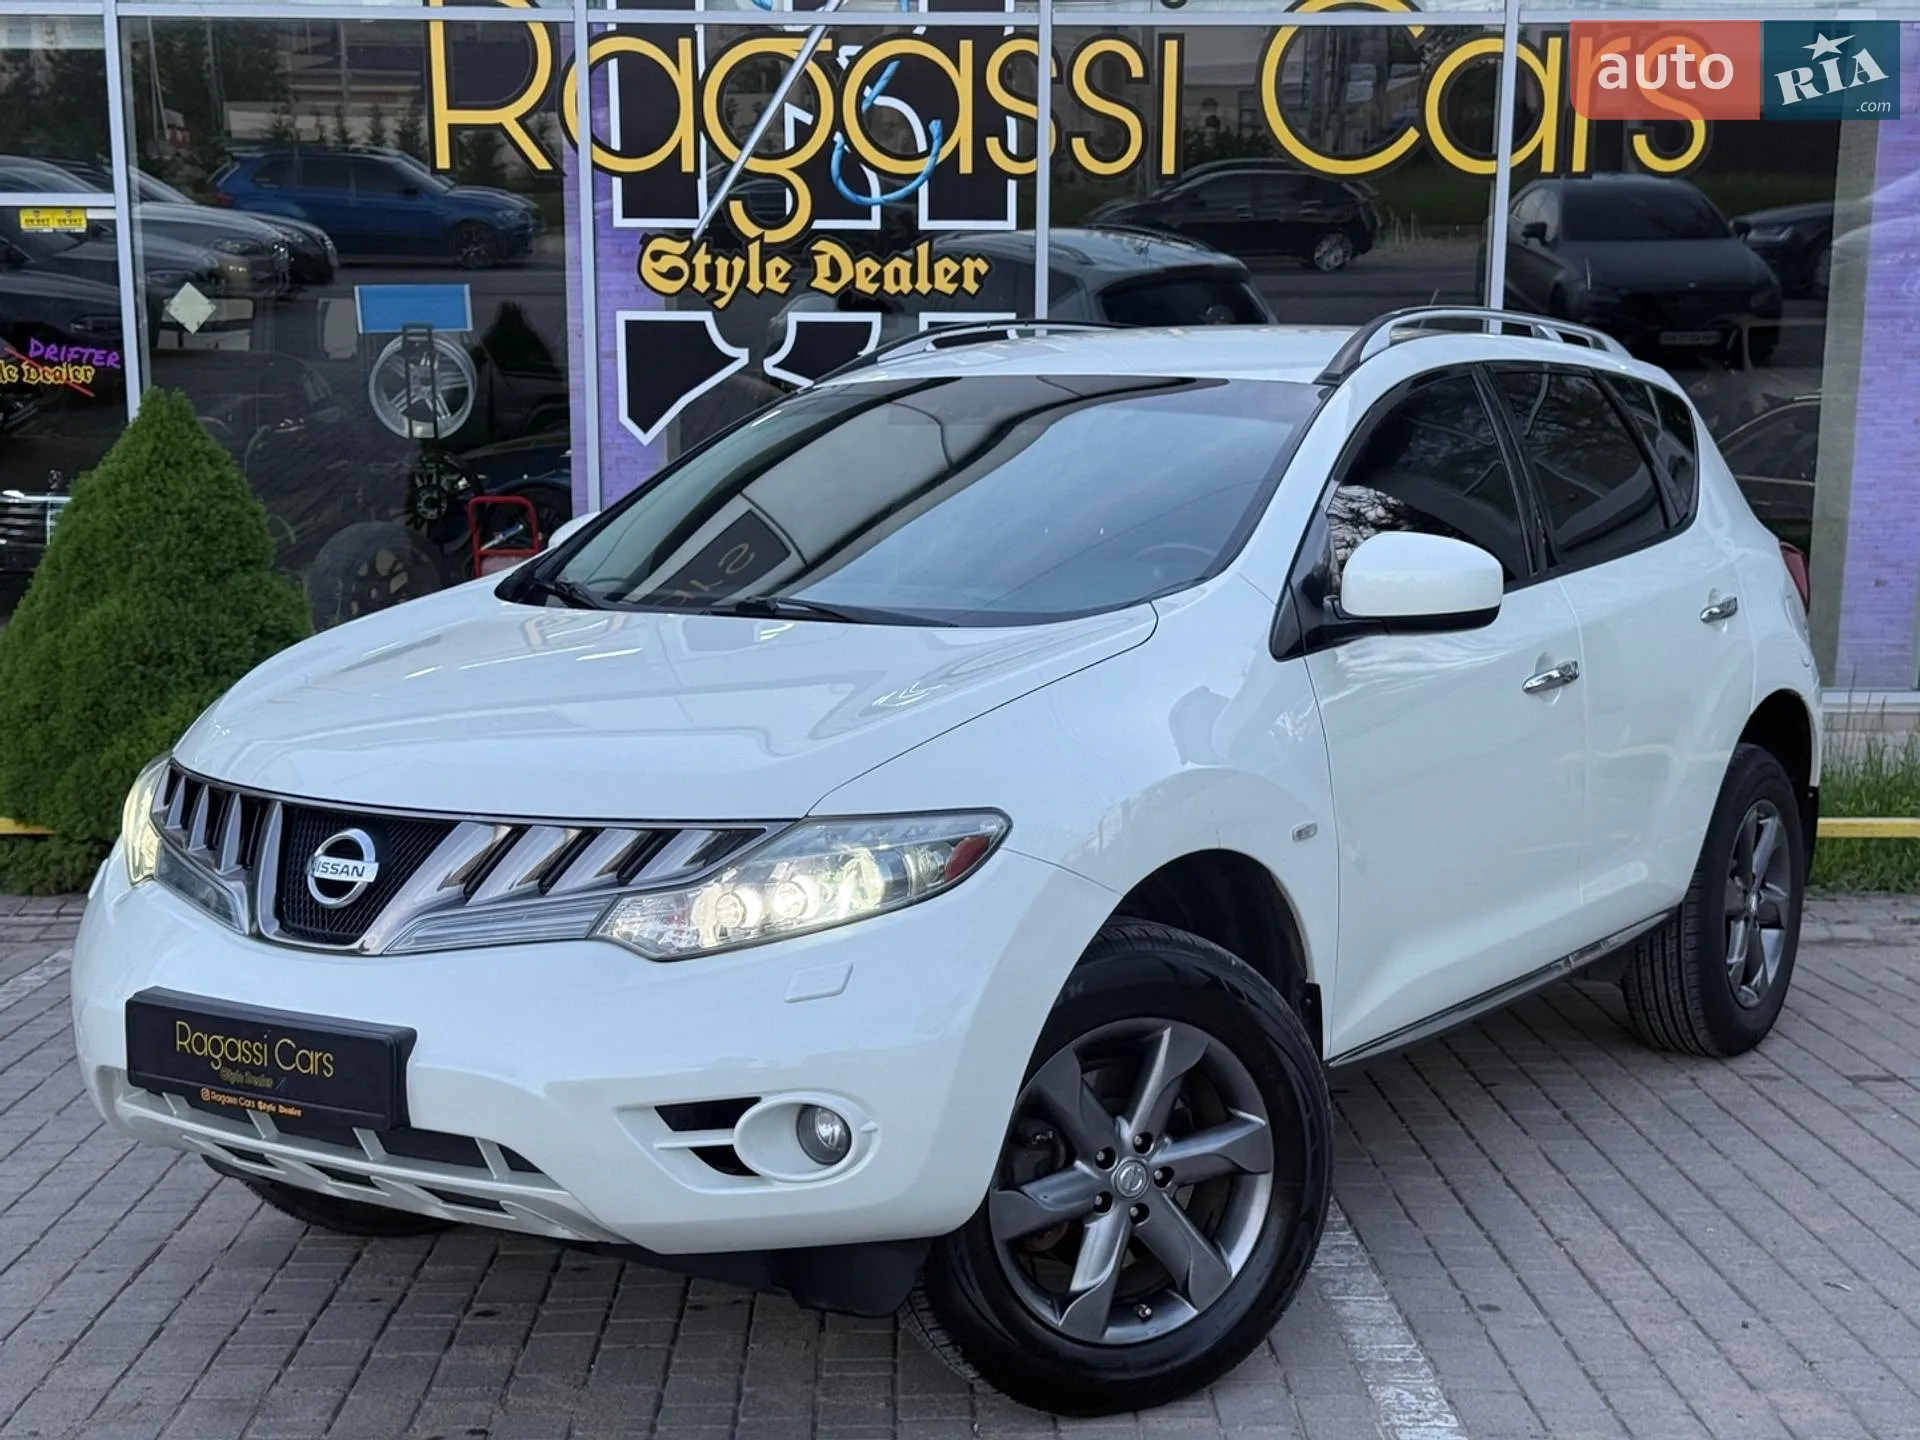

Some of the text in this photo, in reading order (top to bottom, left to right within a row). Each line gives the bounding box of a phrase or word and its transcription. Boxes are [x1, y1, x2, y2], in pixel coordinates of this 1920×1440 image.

[429, 0, 1709, 243] Ragassi Cars
[639, 232, 990, 309] Style Dealer
[20, 360, 97, 386] Dealer
[28, 337, 121, 369] DRIFTER
[175, 1020, 335, 1079] Ragassi Cars
